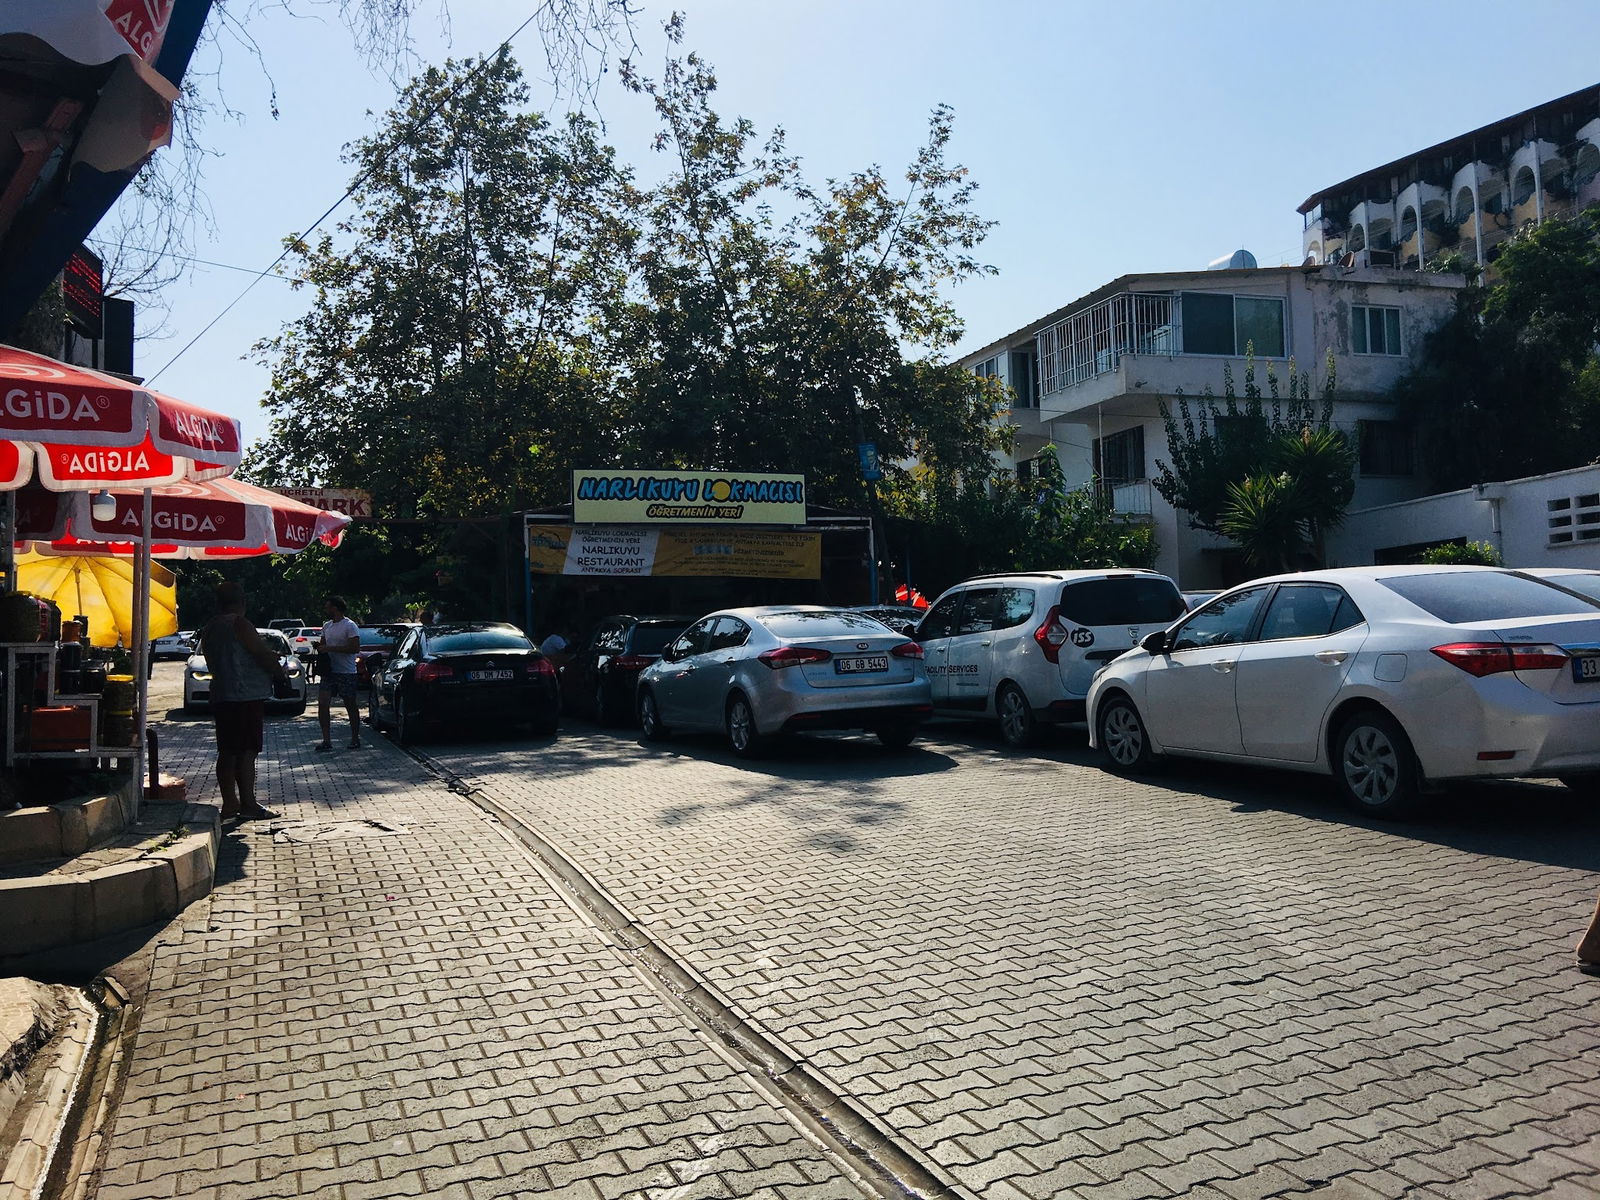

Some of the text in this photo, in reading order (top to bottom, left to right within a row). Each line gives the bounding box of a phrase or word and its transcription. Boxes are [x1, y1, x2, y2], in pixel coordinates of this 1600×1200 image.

[0, 388, 100, 423] GiDA
[578, 477, 699, 501] NARLIKUYU
[648, 505, 742, 518] ÖĞRETMENİN YERİ
[121, 508, 217, 533] AGiDA
[582, 546, 640, 555] NARLIKUYU
[577, 557, 645, 566] RESTAURANT
[841, 660, 851, 670] 06
[868, 658, 887, 669] 5443
[924, 664, 978, 674] FACILITY SERVICES
[1582, 659, 1596, 676] 33
